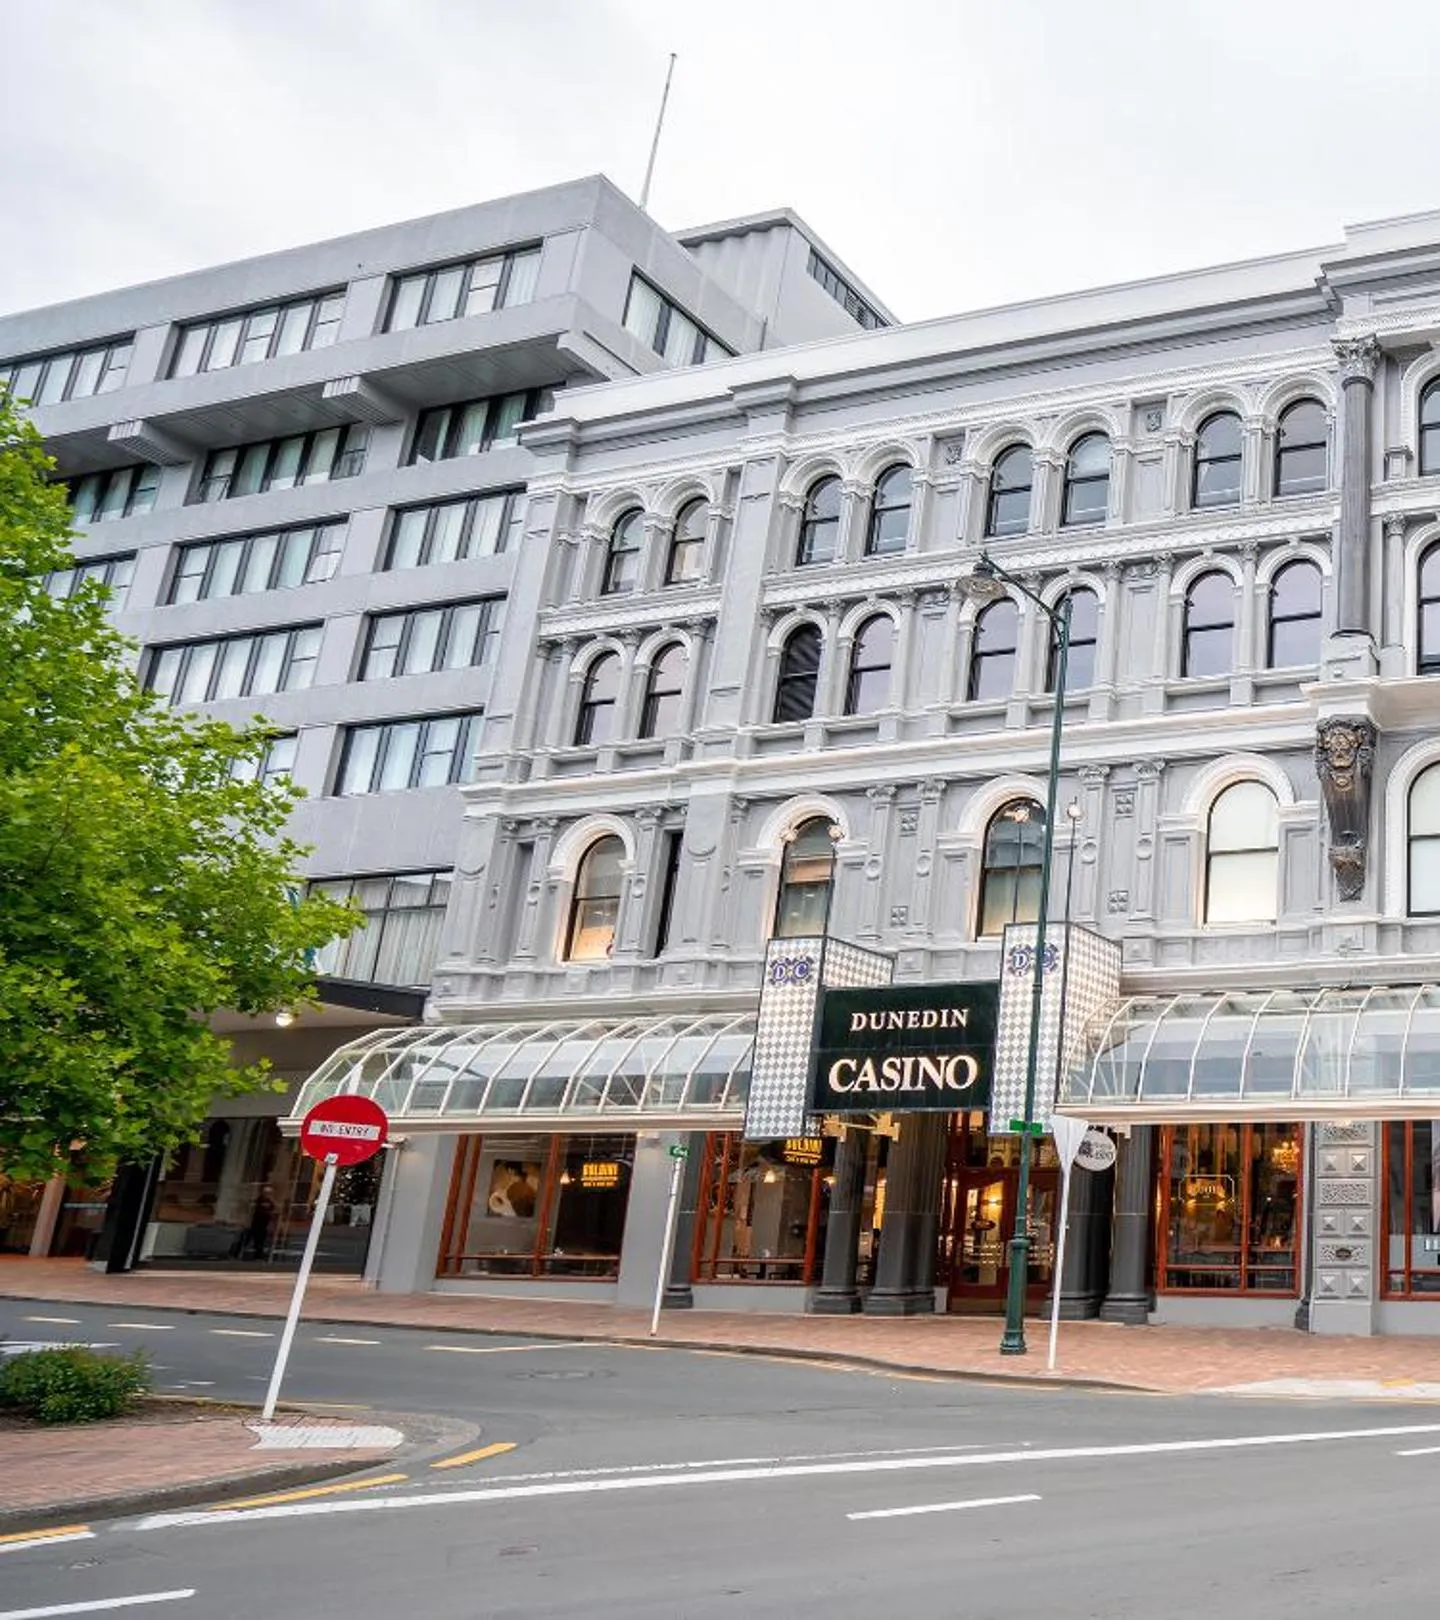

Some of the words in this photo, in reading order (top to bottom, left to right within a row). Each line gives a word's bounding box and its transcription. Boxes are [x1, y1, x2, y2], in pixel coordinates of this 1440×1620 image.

[850, 1008, 969, 1032] DUNEDIN
[828, 1054, 978, 1093] CASINO
[320, 1124, 334, 1134] NO
[339, 1125, 369, 1137] ENTRY
